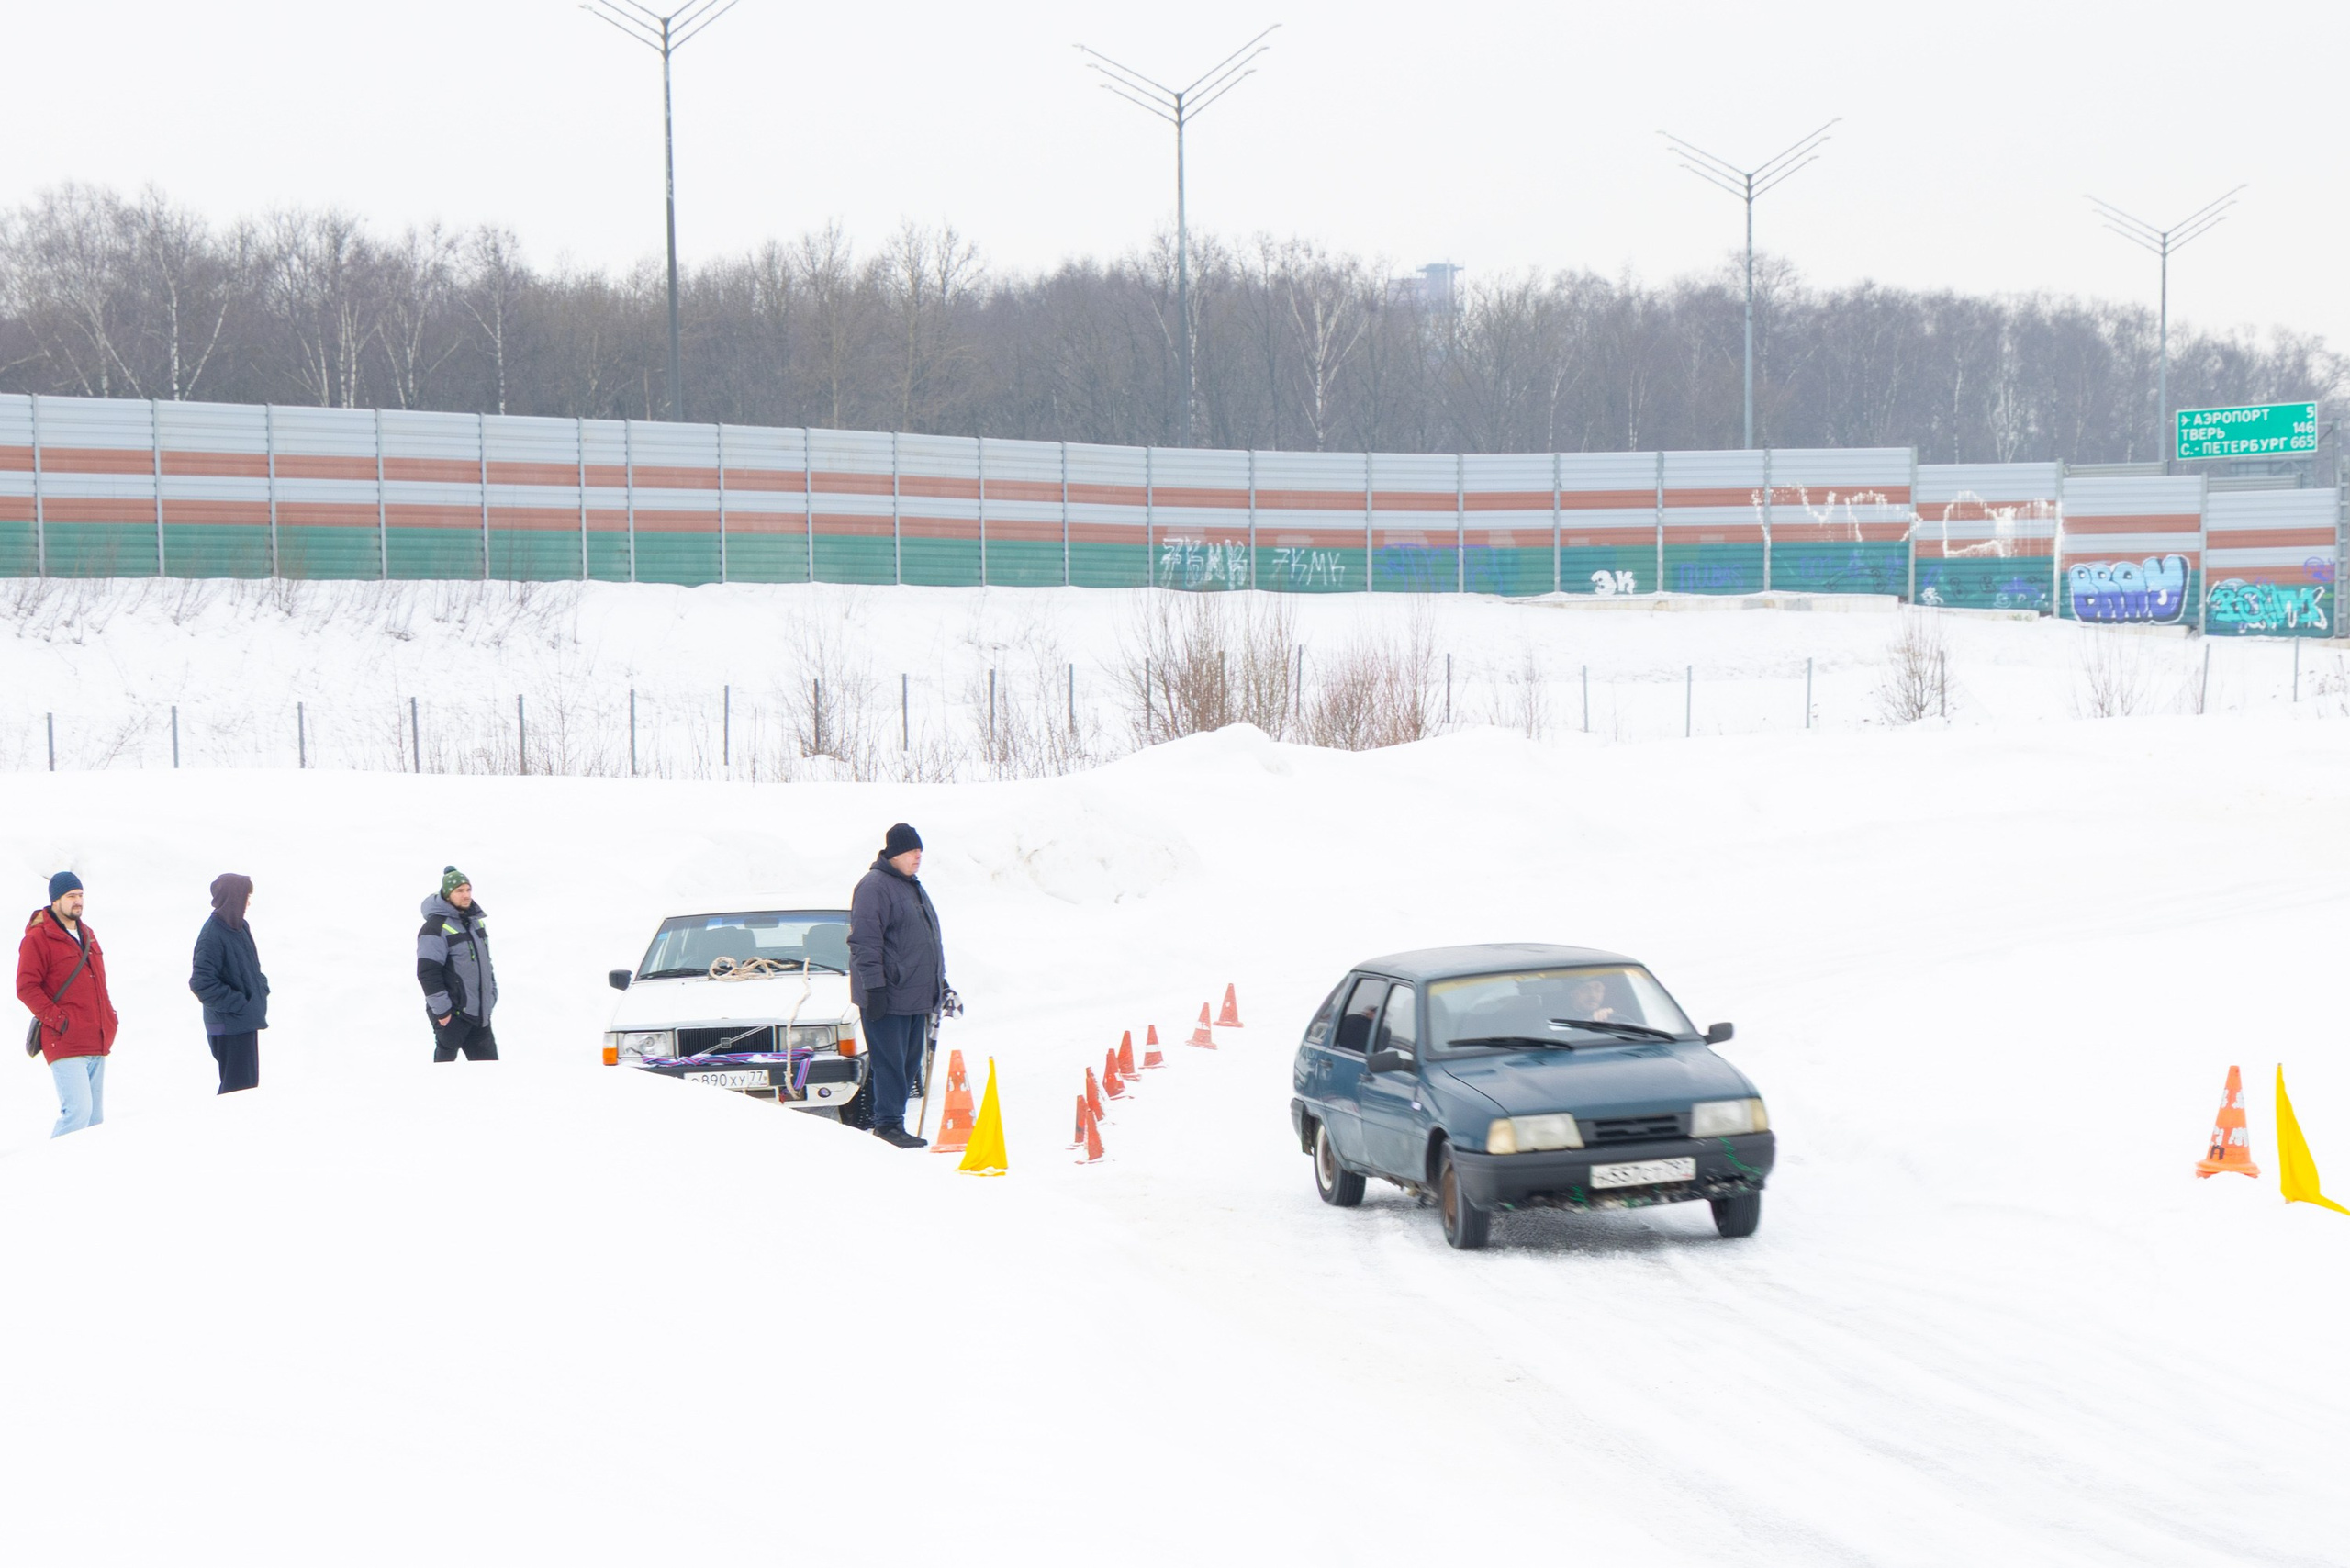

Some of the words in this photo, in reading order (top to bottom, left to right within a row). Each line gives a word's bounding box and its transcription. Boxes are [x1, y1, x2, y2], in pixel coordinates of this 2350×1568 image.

[2193, 409, 2270, 426] АЭРОПОРТ
[2306, 405, 2314, 419] 5
[2180, 427, 2226, 442] ТВЕРЬ
[2292, 420, 2314, 434] 146
[2290, 435, 2314, 449] 665
